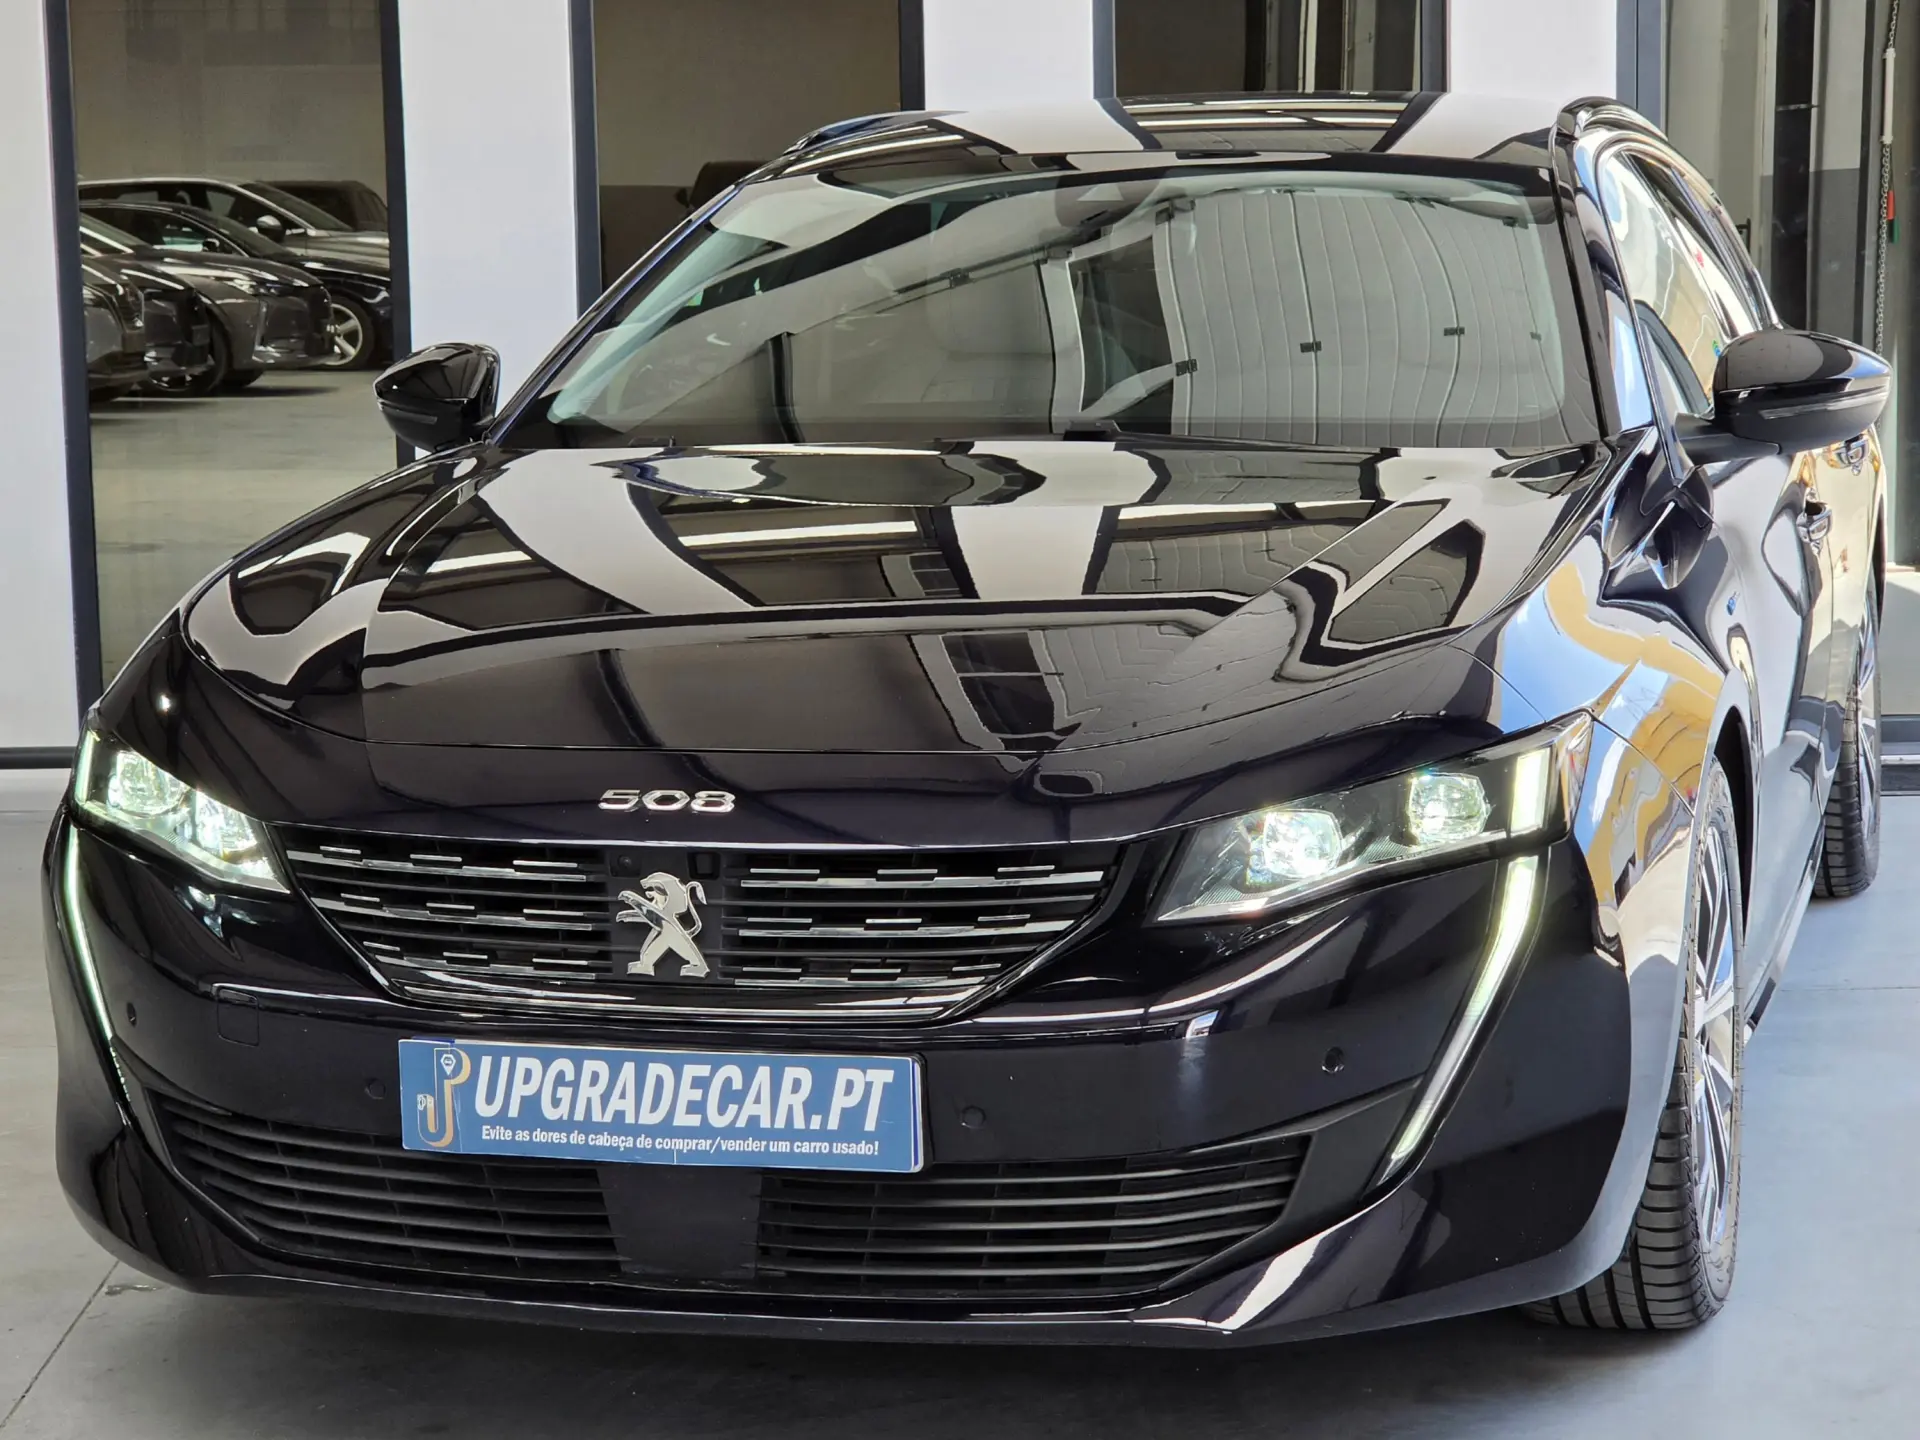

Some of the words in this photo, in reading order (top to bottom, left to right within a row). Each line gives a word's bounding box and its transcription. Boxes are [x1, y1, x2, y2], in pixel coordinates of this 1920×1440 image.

[598, 789, 736, 813] 508
[474, 1055, 895, 1132] UPGRADECAR.PT
[481, 1125, 513, 1141] Evite
[514, 1129, 530, 1142] as
[532, 1128, 567, 1144] dores
[569, 1130, 586, 1145] de
[587, 1131, 634, 1151] cabeça
[636, 1134, 653, 1149] de
[655, 1136, 767, 1153] comprar/vender
[769, 1140, 791, 1153] um
[793, 1141, 830, 1154] carro
[832, 1141, 880, 1156] usado!
